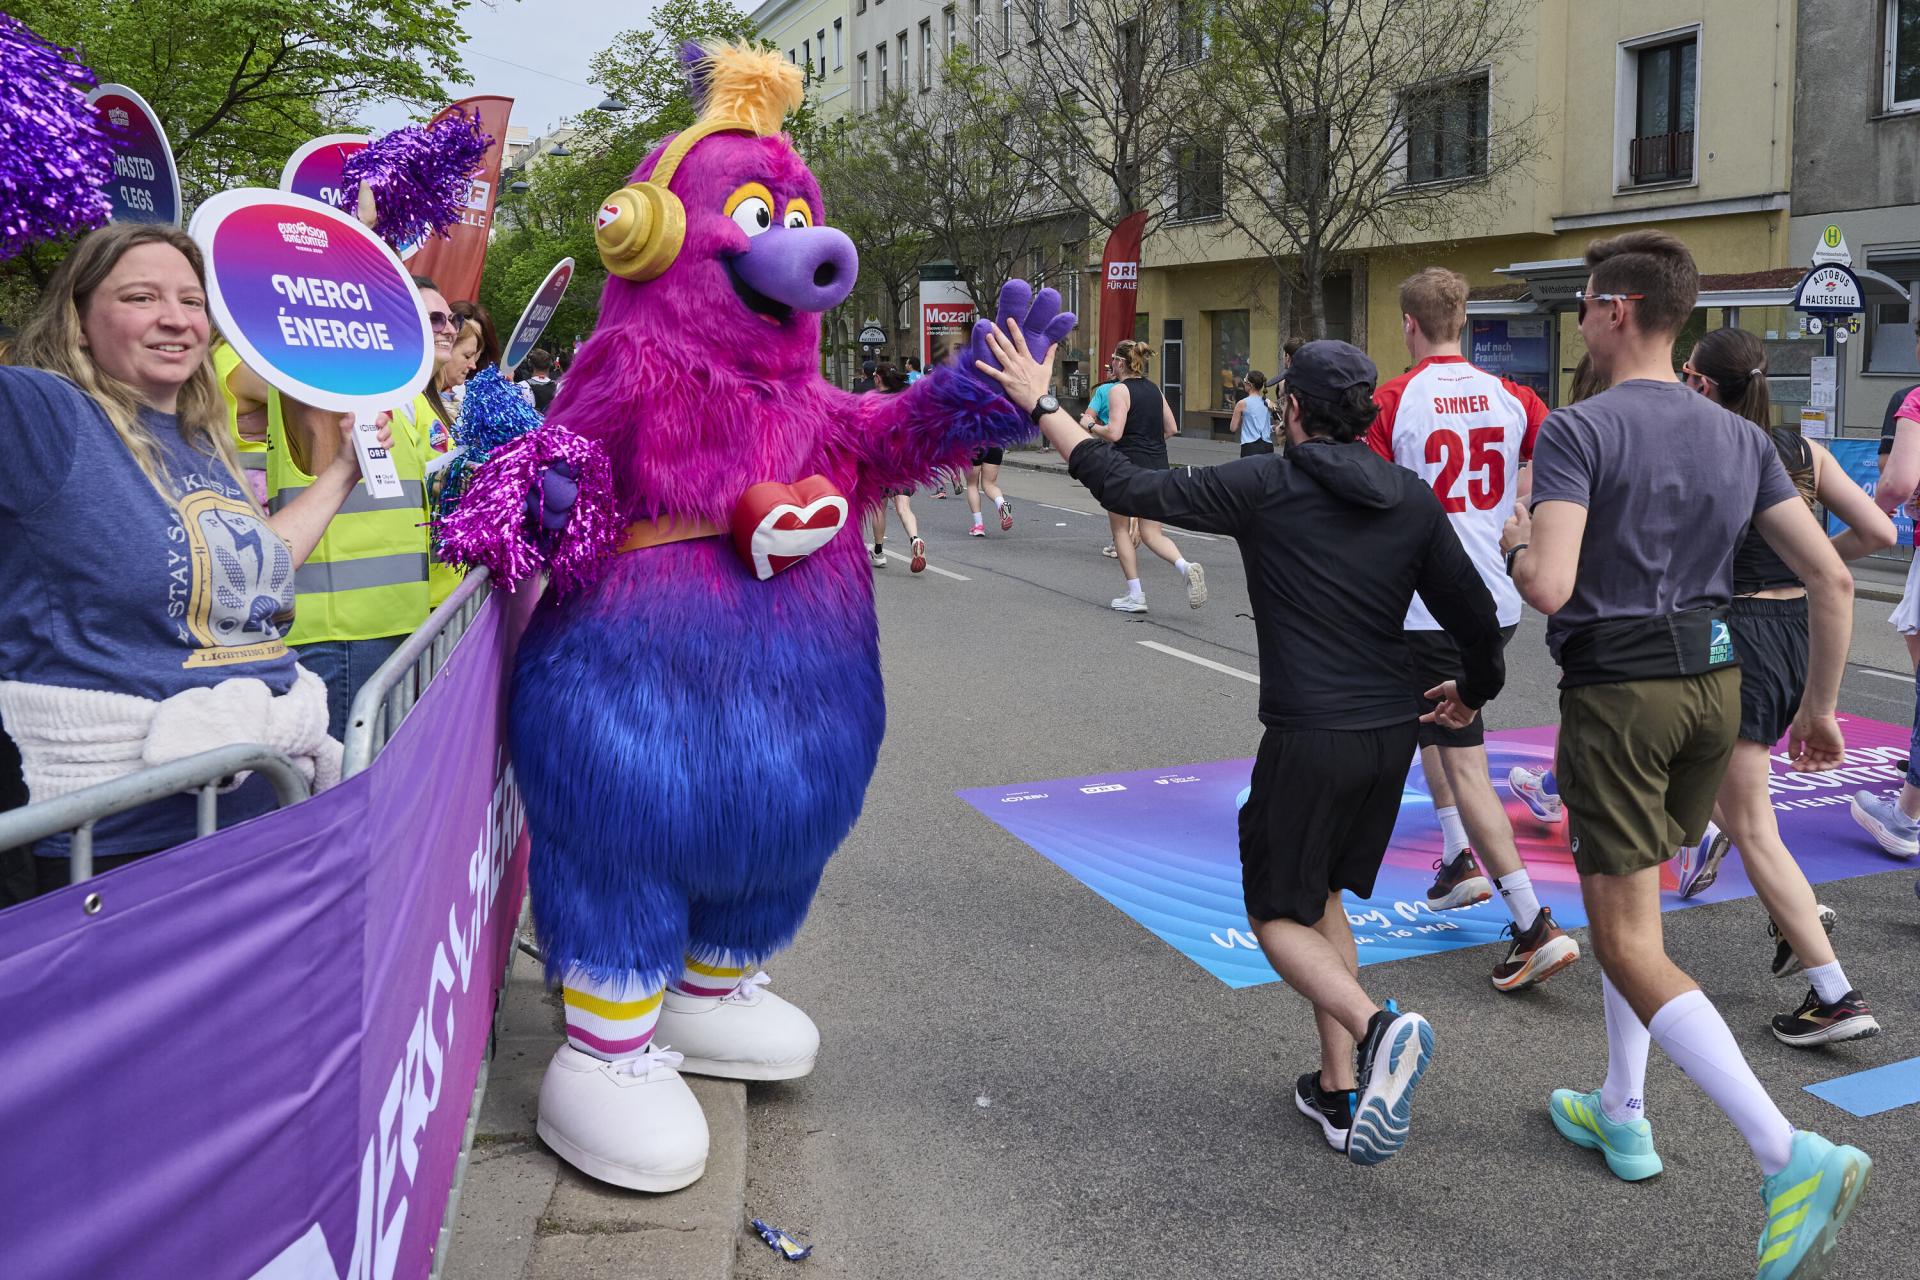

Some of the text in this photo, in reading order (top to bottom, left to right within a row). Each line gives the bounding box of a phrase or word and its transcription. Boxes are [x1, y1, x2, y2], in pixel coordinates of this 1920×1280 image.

[113, 155, 155, 181] WASTED
[120, 185, 154, 212] LEGS
[460, 212, 486, 228] LLE
[1828, 228, 1837, 243] H
[1107, 280, 1122, 290] FÜR
[1813, 270, 1850, 287] AUTOBUS
[271, 274, 372, 311] MERCI
[1805, 295, 1856, 305] HALTESTELLE
[277, 306, 394, 351] ÉNERGIE
[1475, 342, 1512, 352] Auf nach
[1434, 395, 1490, 414] SINNER
[369, 449, 385, 457] ORF
[1424, 427, 1505, 513] 25
[168, 549, 188, 618] STAY
[1343, 908, 1392, 928] by
[1387, 929, 1413, 938] 16
[1416, 921, 1459, 934] MAI
